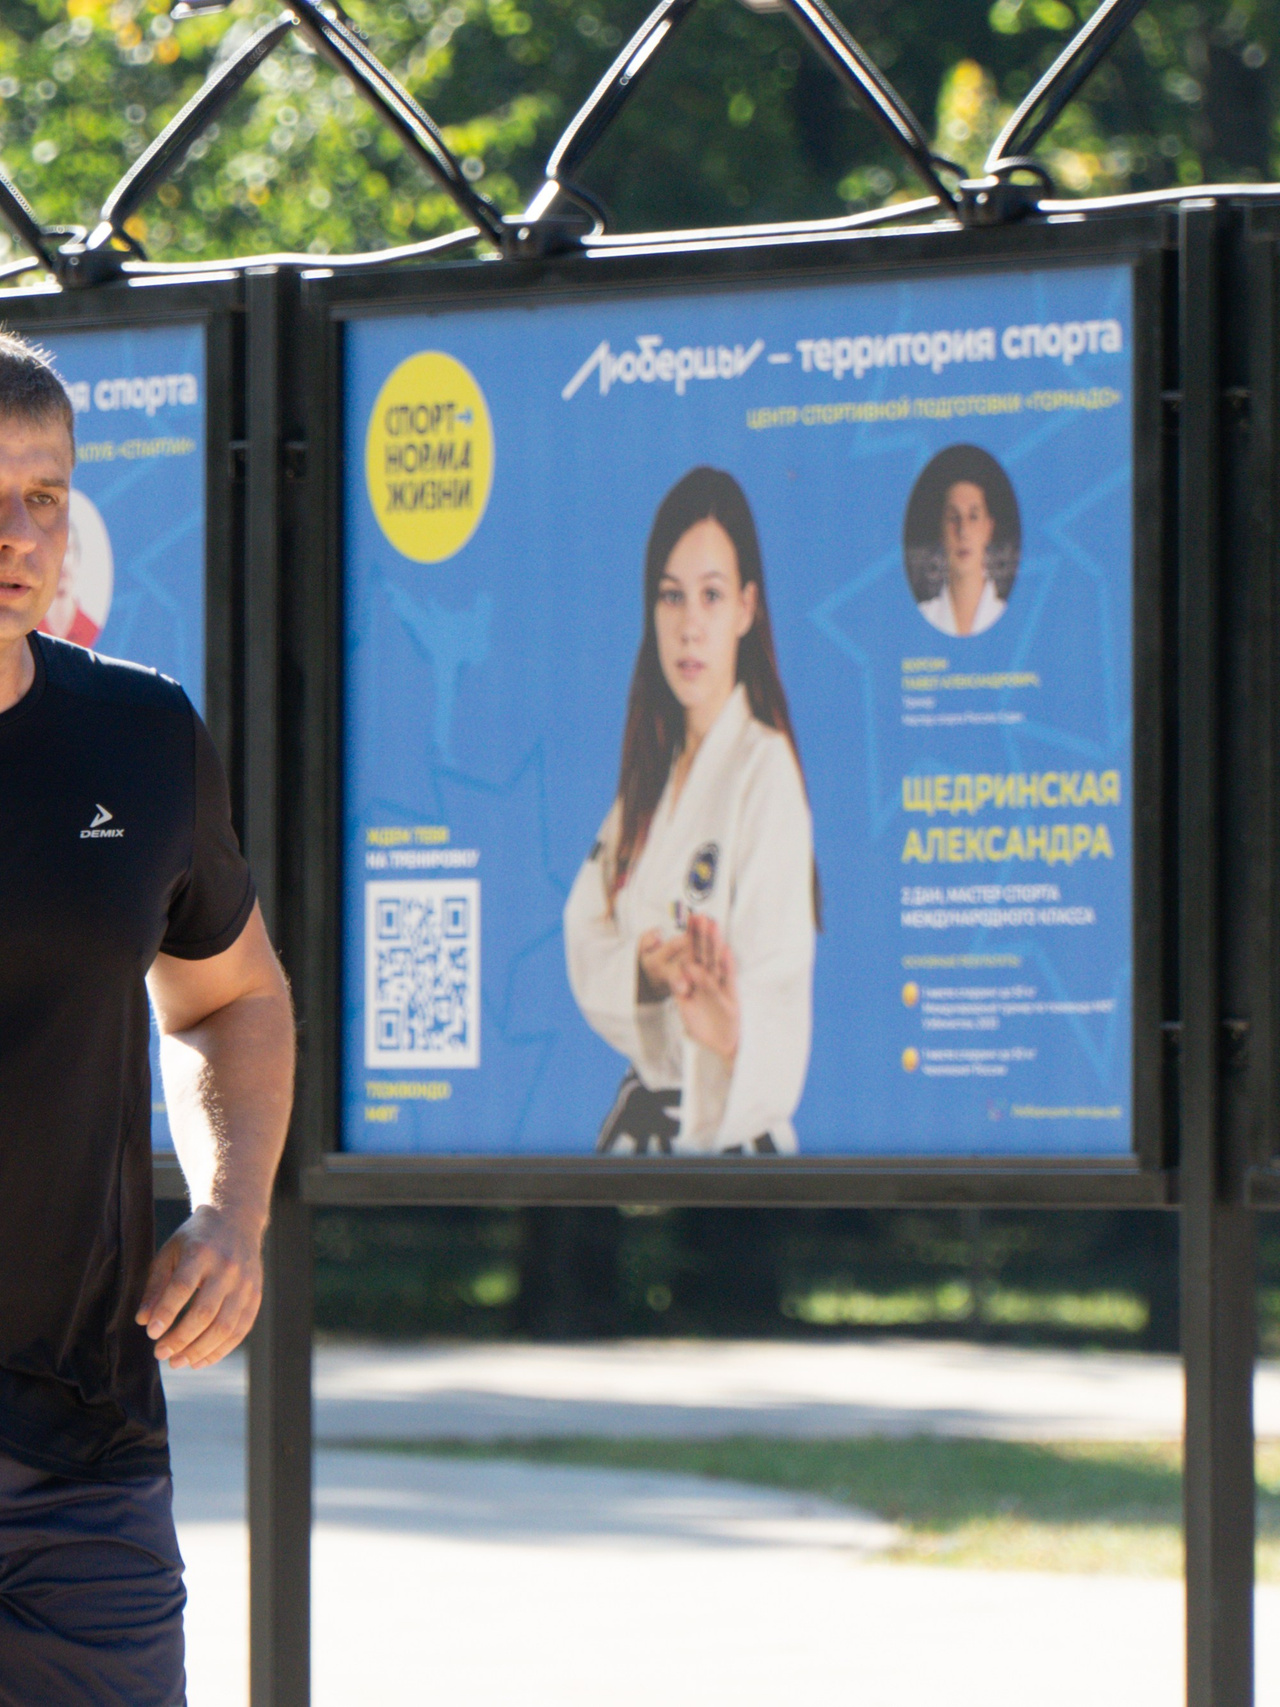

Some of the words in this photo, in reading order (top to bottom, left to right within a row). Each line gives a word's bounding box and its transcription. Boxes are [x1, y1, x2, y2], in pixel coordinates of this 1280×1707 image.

[561, 333, 766, 401] Люберцы
[796, 326, 996, 381] территория
[1001, 318, 1123, 367] спорта
[94, 373, 198, 417] спорта
[746, 403, 801, 430] ЦЕНТР
[801, 395, 910, 426] СПОРТИВНОЙ
[913, 392, 1021, 420] ПОДГОТОВКИ
[384, 402, 456, 436] СПОРТ
[384, 441, 474, 475] НОРМА
[384, 478, 474, 515] ЖИЗНИ
[902, 769, 1120, 817] ЩЕДРИНСКАЯ
[80, 829, 125, 839] DEMIX
[901, 823, 1115, 867] АЛЕКСАНДРА
